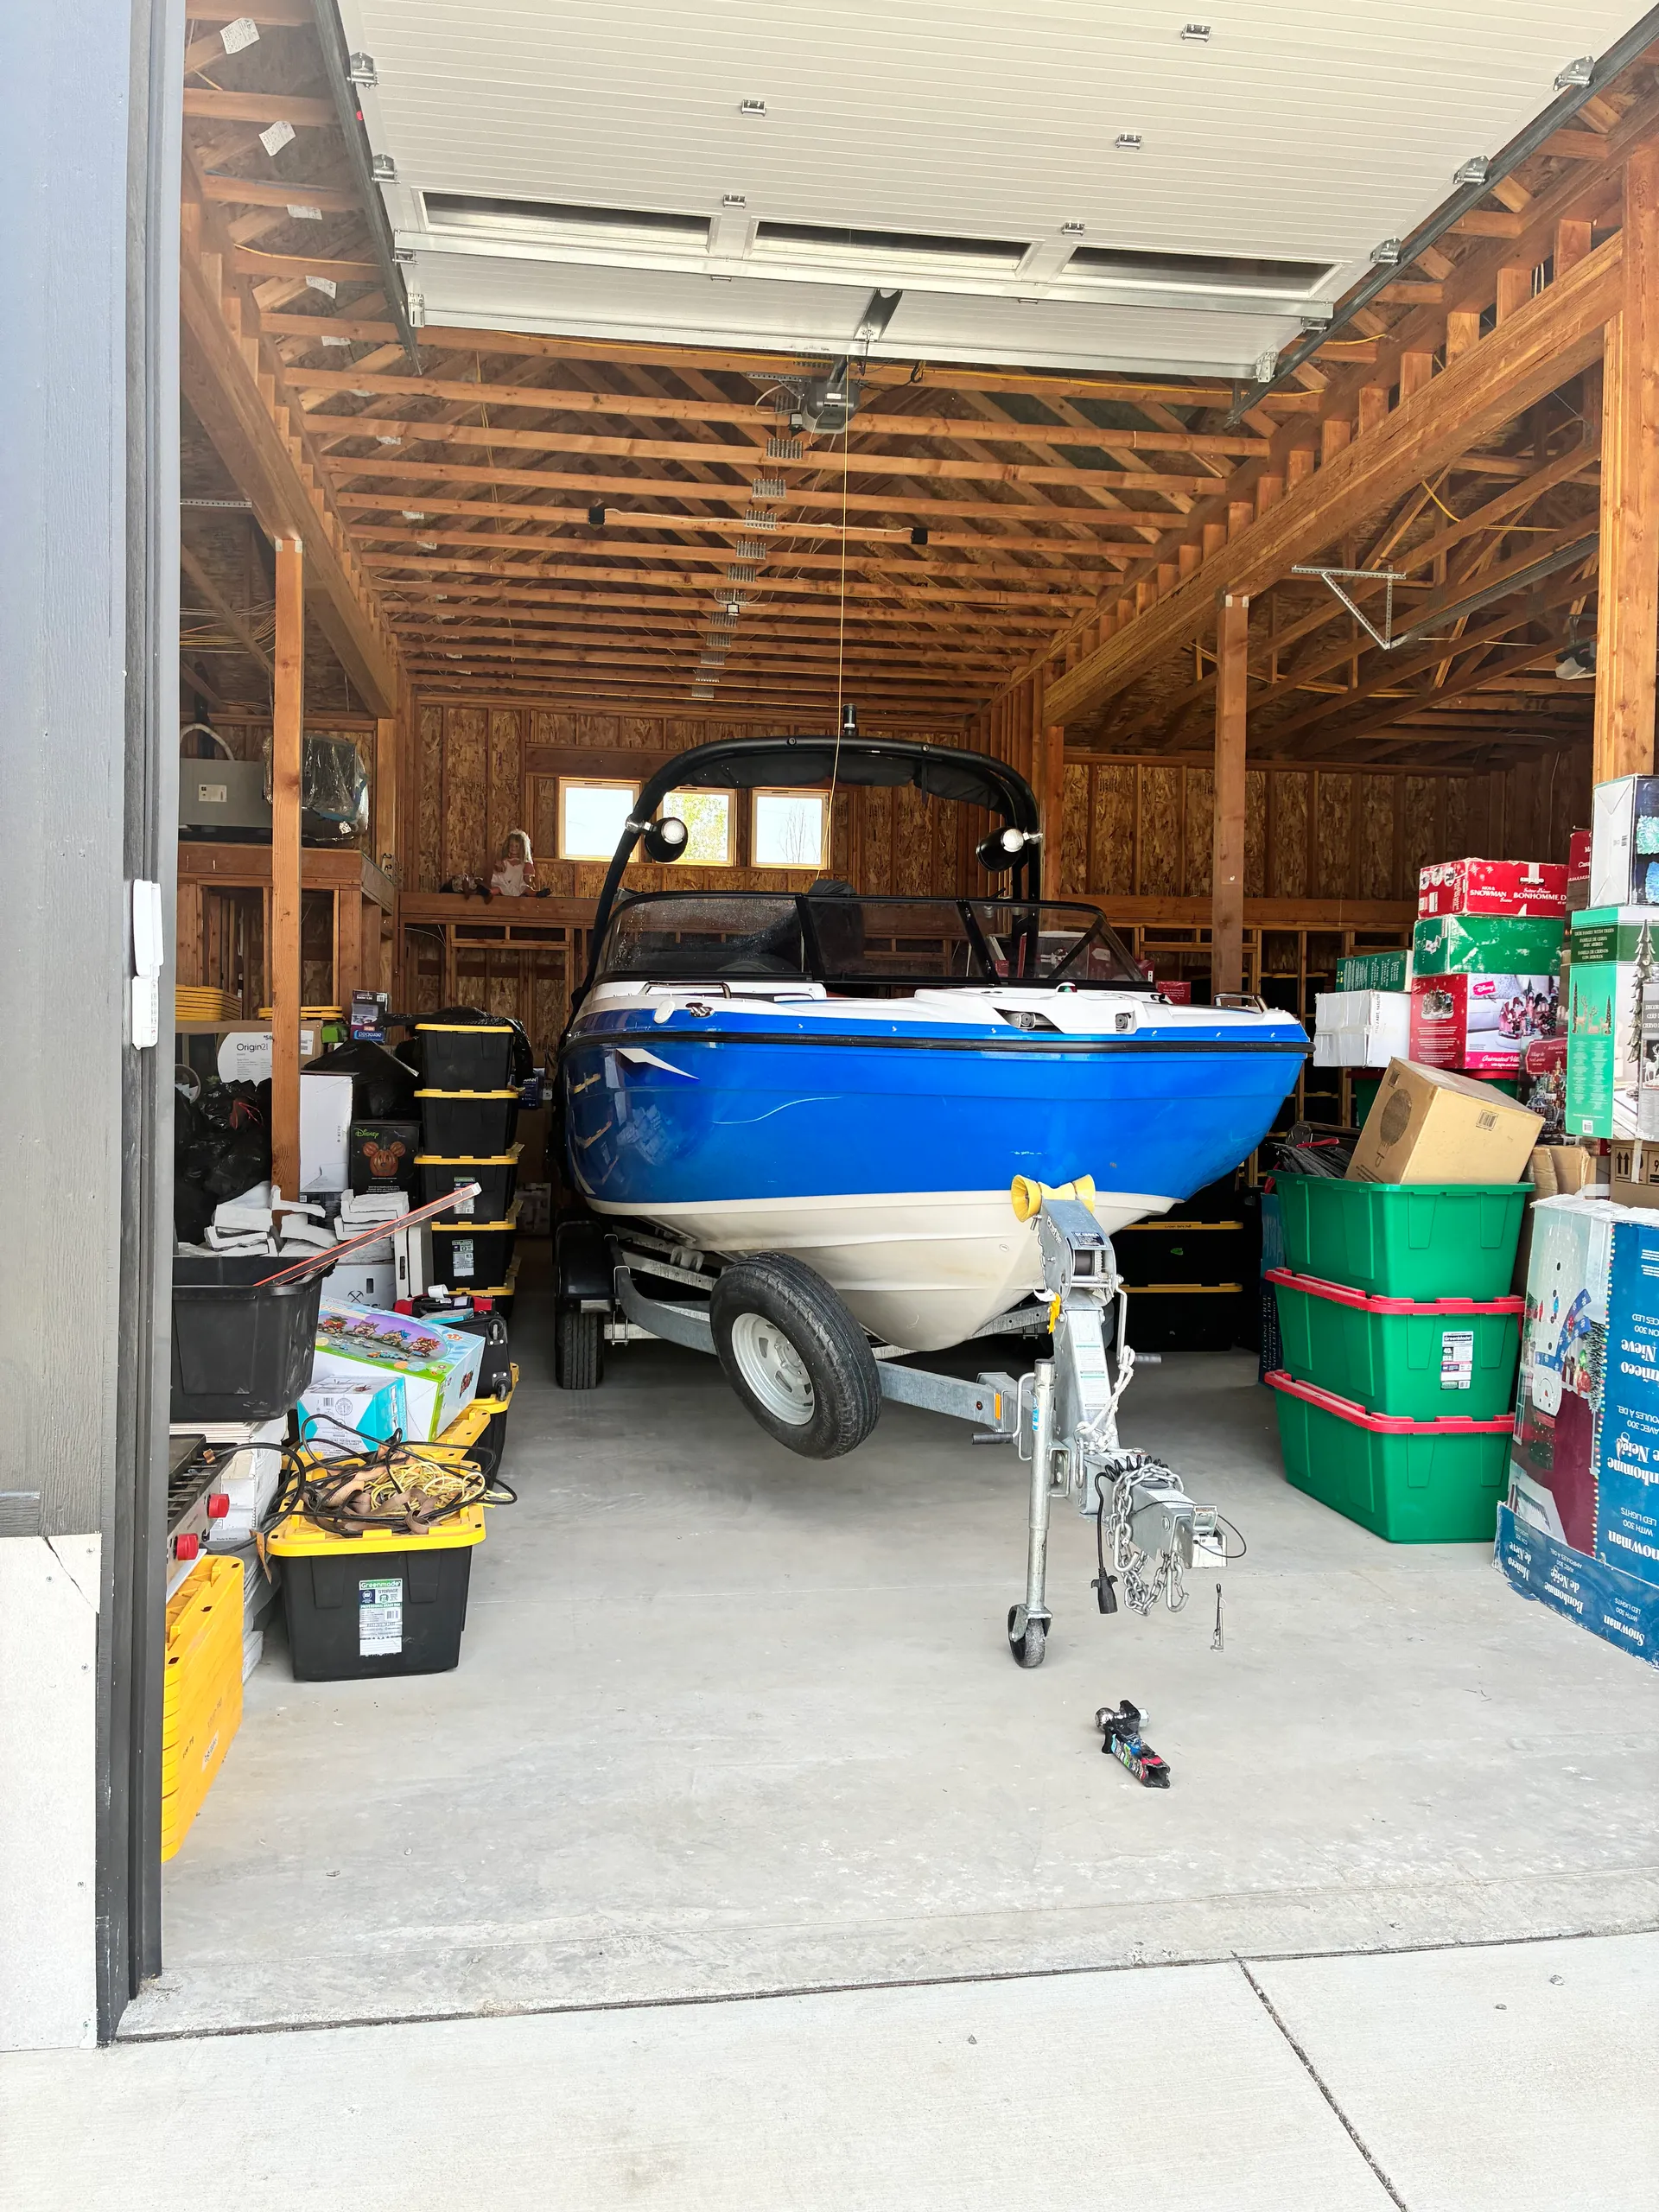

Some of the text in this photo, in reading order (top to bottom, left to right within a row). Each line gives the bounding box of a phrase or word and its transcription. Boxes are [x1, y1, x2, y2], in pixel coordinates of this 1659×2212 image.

[1514, 892, 1559, 900] BONHOMME
[353, 1128, 379, 1139] Disney
[1632, 1313, 1645, 1323] LED
[1634, 1325, 1647, 1334] 300
[1621, 1339, 1656, 1363] Nieve
[1617, 1405, 1629, 1415] DEL
[1627, 1420, 1659, 1434] AVEC 300
[1621, 1507, 1657, 1526] LED LIGHTS
[1623, 1519, 1654, 1536] WITH 300
[1510, 1541, 1532, 1565] de Nieve
[1608, 1529, 1659, 1560] nowman
[1508, 1557, 1530, 1581] Muñeco
[1551, 1565, 1580, 1593] de Neige
[1544, 1581, 1583, 1614] Bonhomme
[1614, 1597, 1641, 1614] LED LIGHTS
[1616, 1607, 1638, 1622] WITH 300
[1604, 1614, 1645, 1647] Snowman
